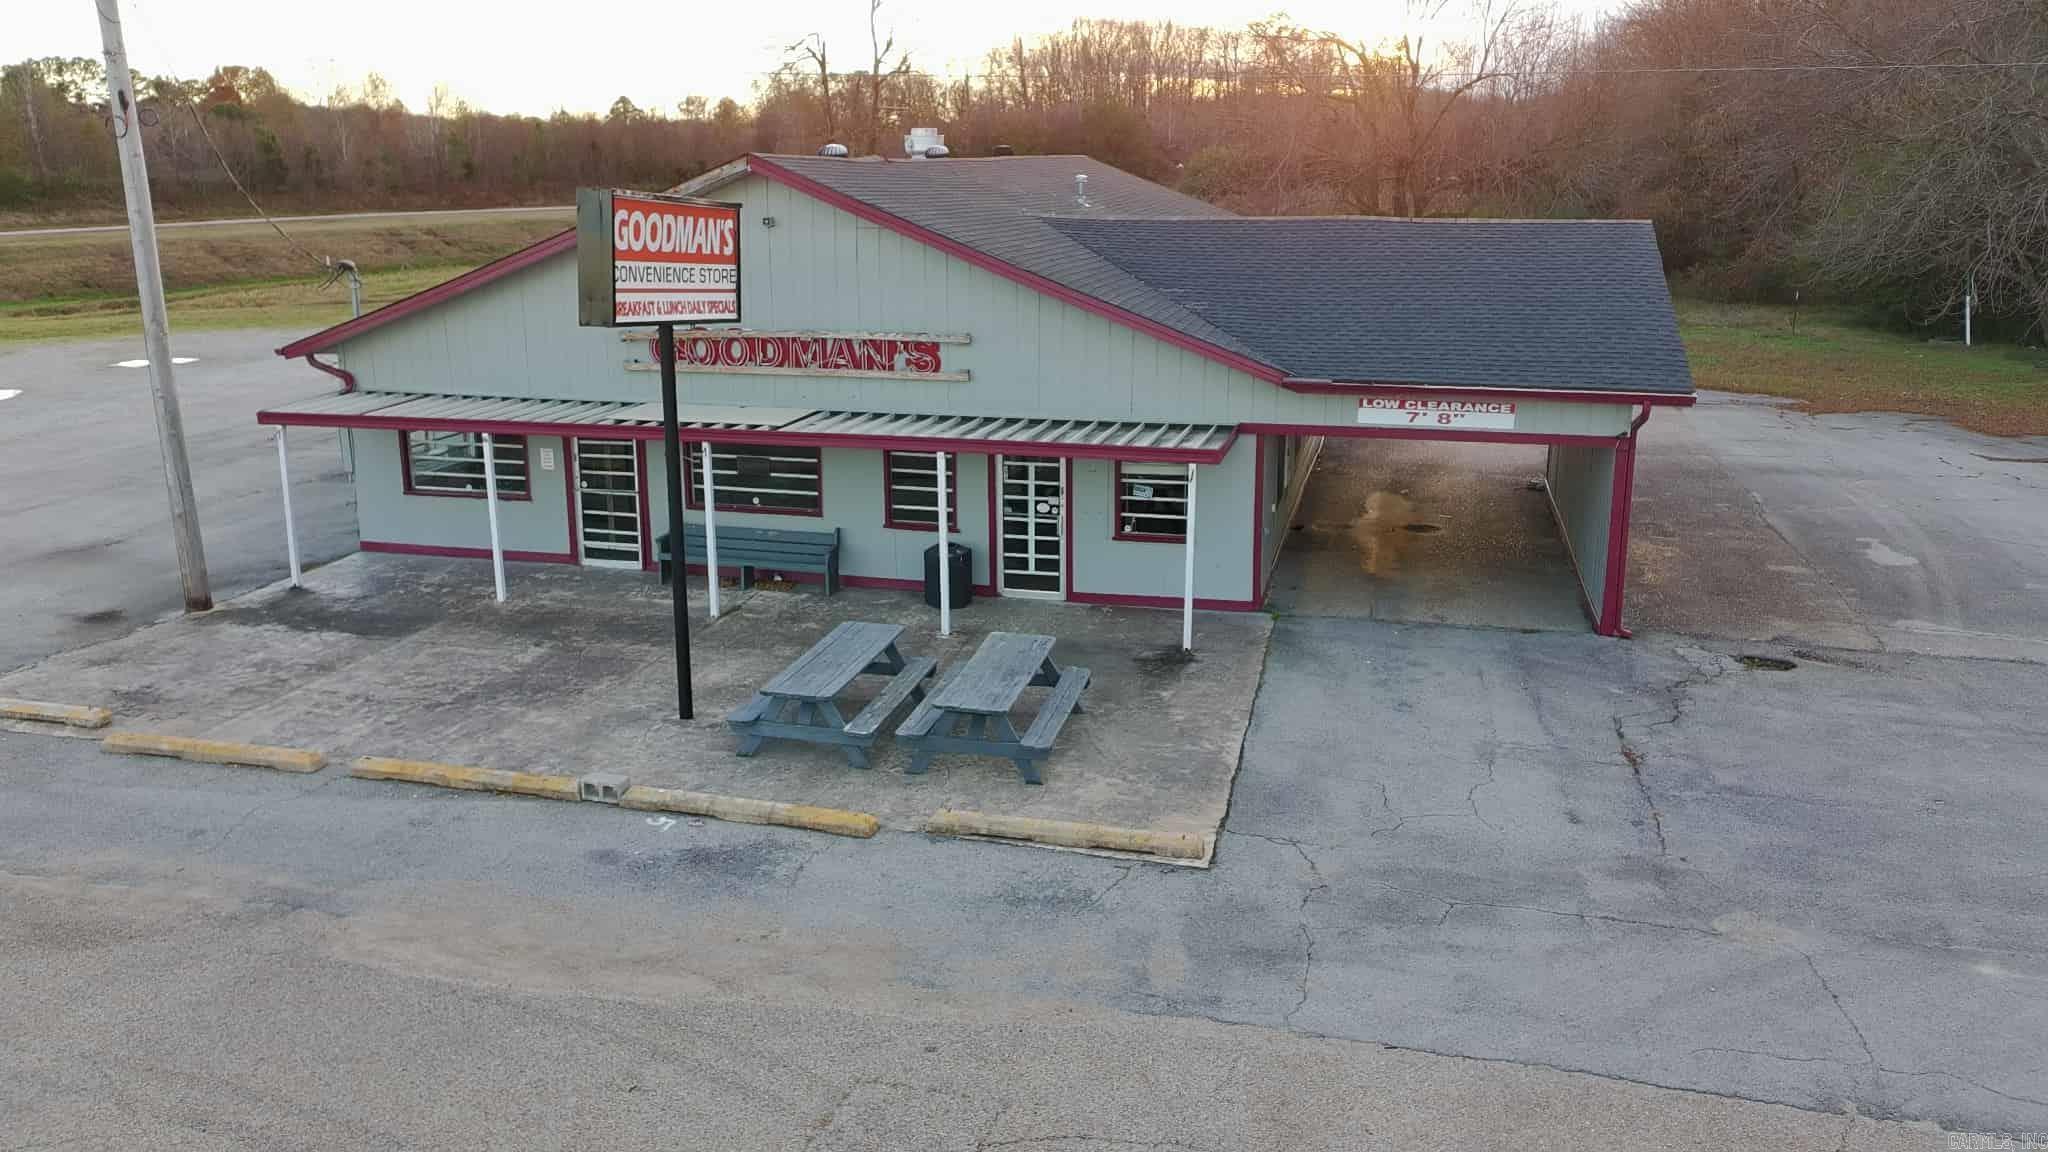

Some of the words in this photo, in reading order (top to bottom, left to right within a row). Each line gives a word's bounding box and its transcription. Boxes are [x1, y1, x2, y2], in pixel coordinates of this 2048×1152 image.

[614, 208, 734, 256] GOODMAN'S
[615, 265, 695, 284] CONVENIENCE
[699, 267, 737, 284] STORE
[664, 300, 688, 315] LUNCH
[1362, 398, 1400, 409] LOW
[1405, 400, 1513, 414] CLEARANCE
